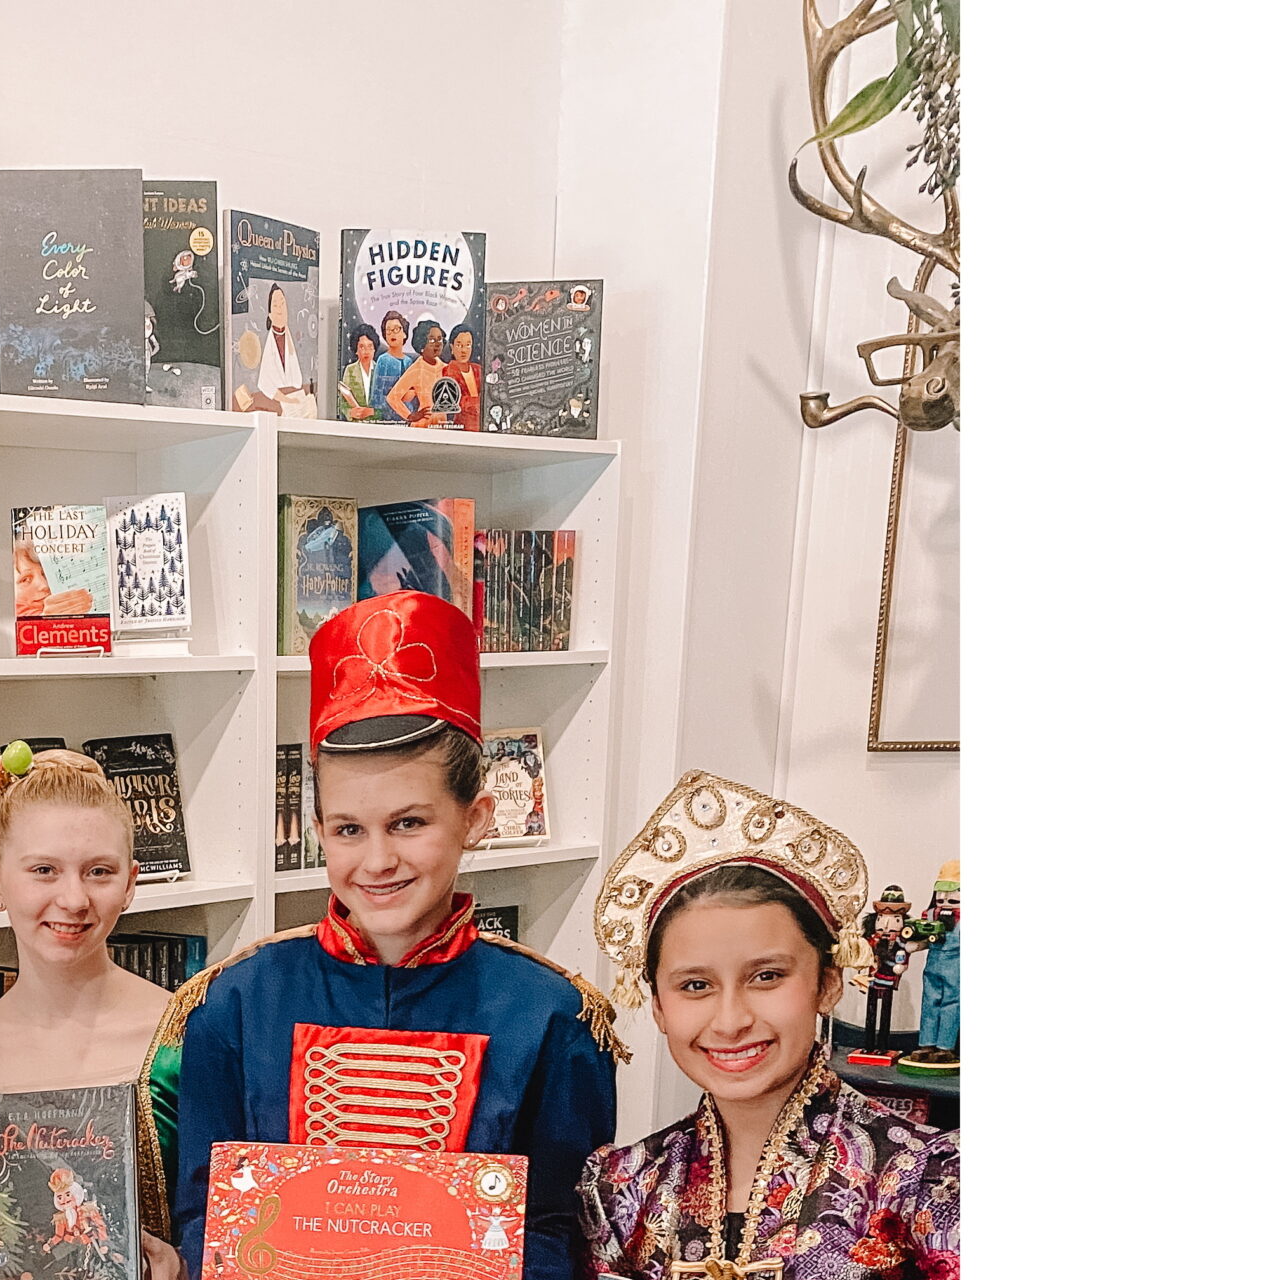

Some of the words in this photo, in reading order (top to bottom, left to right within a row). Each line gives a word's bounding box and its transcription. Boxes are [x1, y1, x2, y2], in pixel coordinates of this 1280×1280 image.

[163, 198, 208, 214] IDEAS
[40, 231, 95, 262] Every
[237, 219, 276, 250] Queen
[283, 229, 317, 262] Physics
[368, 240, 460, 267] HIDDEN
[42, 260, 90, 281] Color
[366, 264, 465, 292] FIGURES
[57, 282, 76, 301] of
[35, 296, 98, 320] Light
[505, 317, 561, 343] WOMEN
[562, 315, 573, 330] IN
[506, 335, 572, 366] SCIENCE
[33, 510, 54, 522] THE
[59, 510, 86, 521] LAST
[21, 523, 99, 541] HOLIDAY
[33, 543, 86, 554] CONCERT
[302, 573, 326, 597] Harry
[325, 573, 350, 595] Potter
[19, 625, 110, 645] Clements
[494, 769, 519, 789] LAND
[492, 789, 533, 809] STORIES
[26, 1118, 115, 1160] Nutcracker
[339, 1170, 359, 1181] The
[359, 1169, 395, 1187] Story
[326, 1179, 399, 1198] Orchestra
[324, 1200, 331, 1215] I
[334, 1201, 366, 1216] CAN
[370, 1203, 402, 1218] PLAY
[293, 1216, 323, 1232] THE
[327, 1219, 433, 1238] NUTCRACKER
